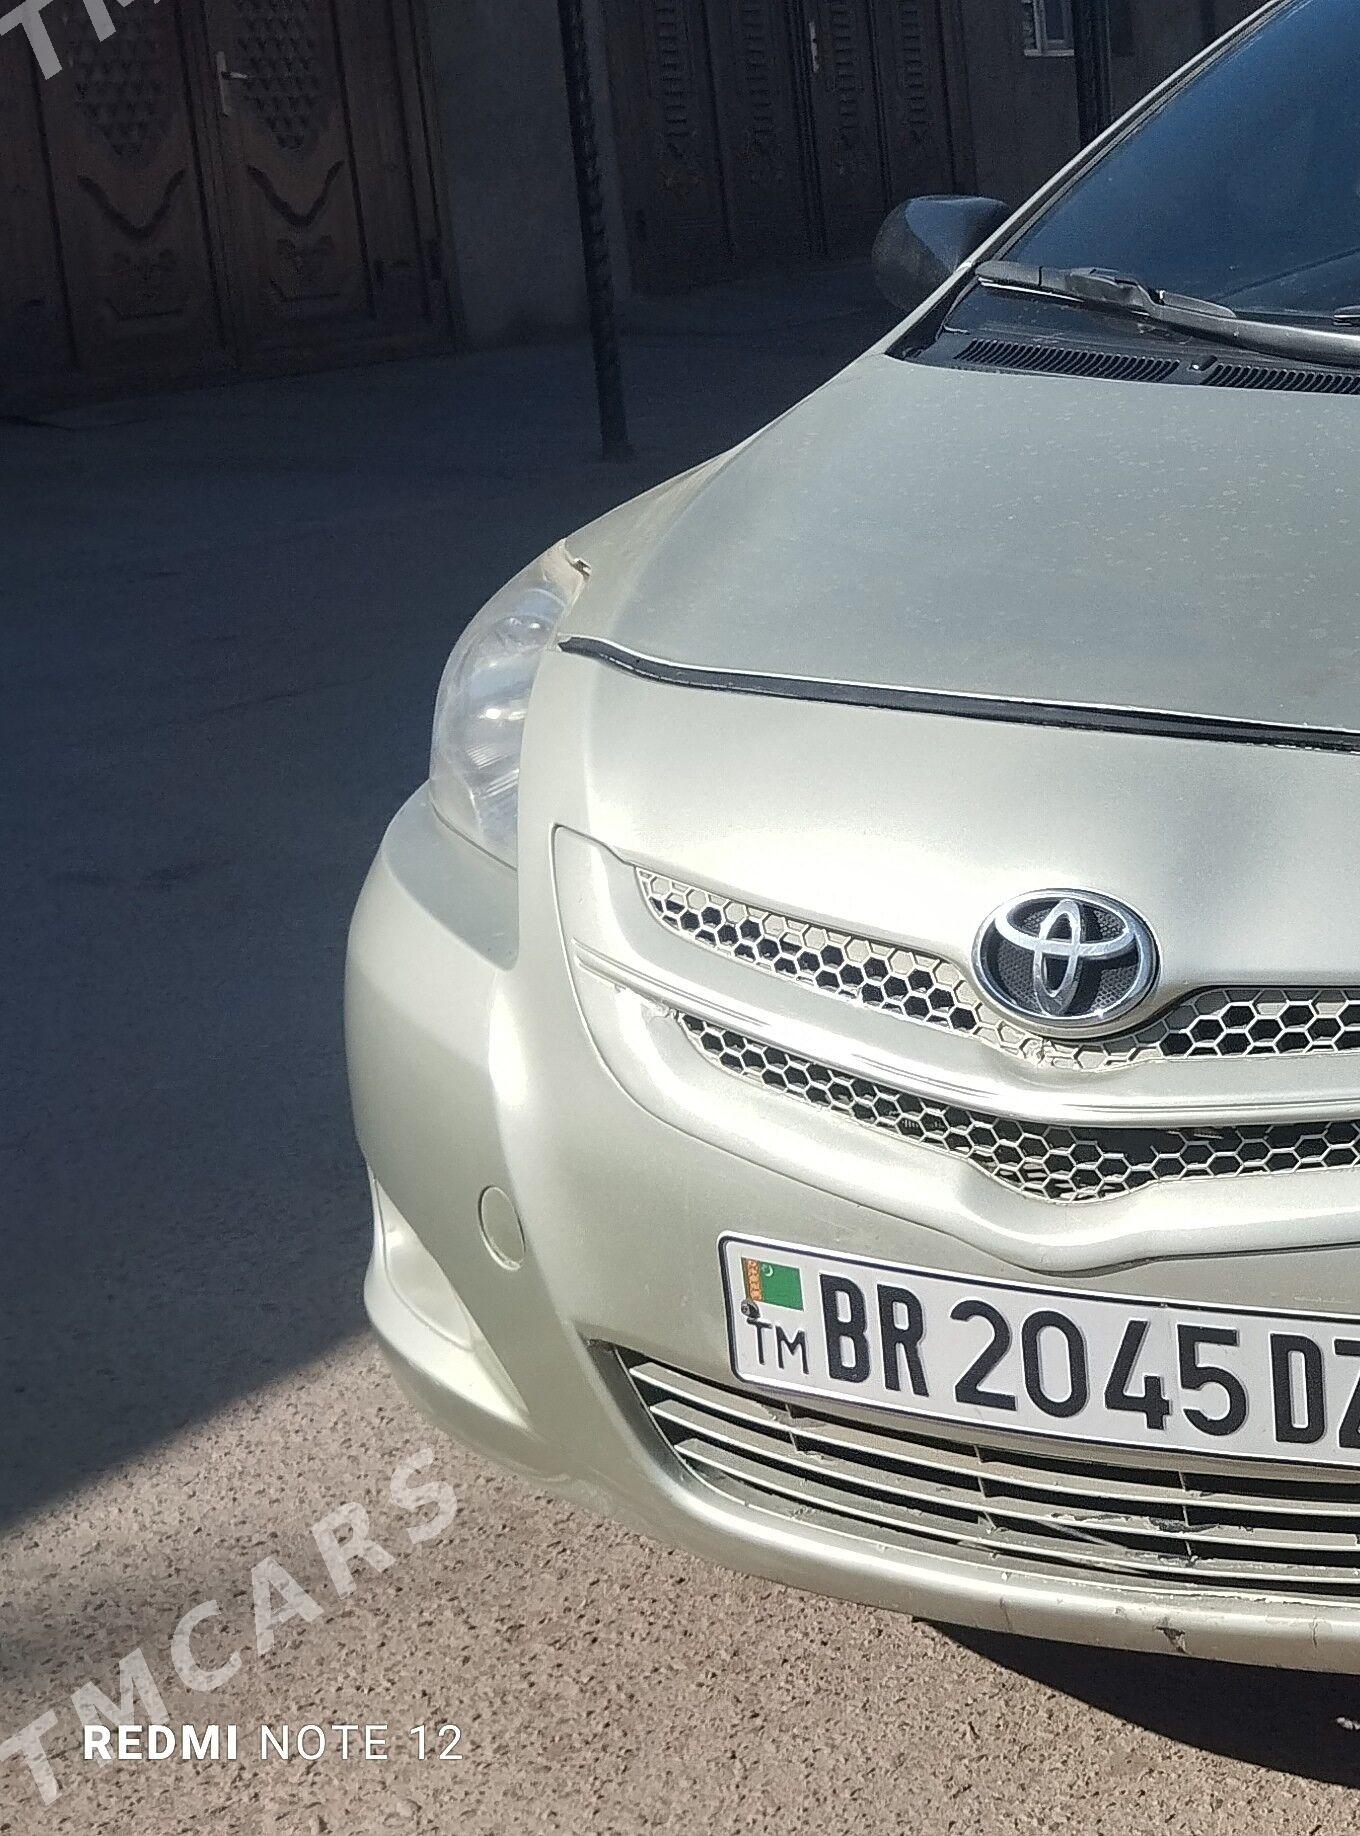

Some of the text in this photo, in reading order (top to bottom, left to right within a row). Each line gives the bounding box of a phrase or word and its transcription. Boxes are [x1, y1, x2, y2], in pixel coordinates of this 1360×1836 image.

[746, 1318, 809, 1375] TM
[818, 1273, 930, 1398] BR
[949, 1299, 1248, 1437] 2045
